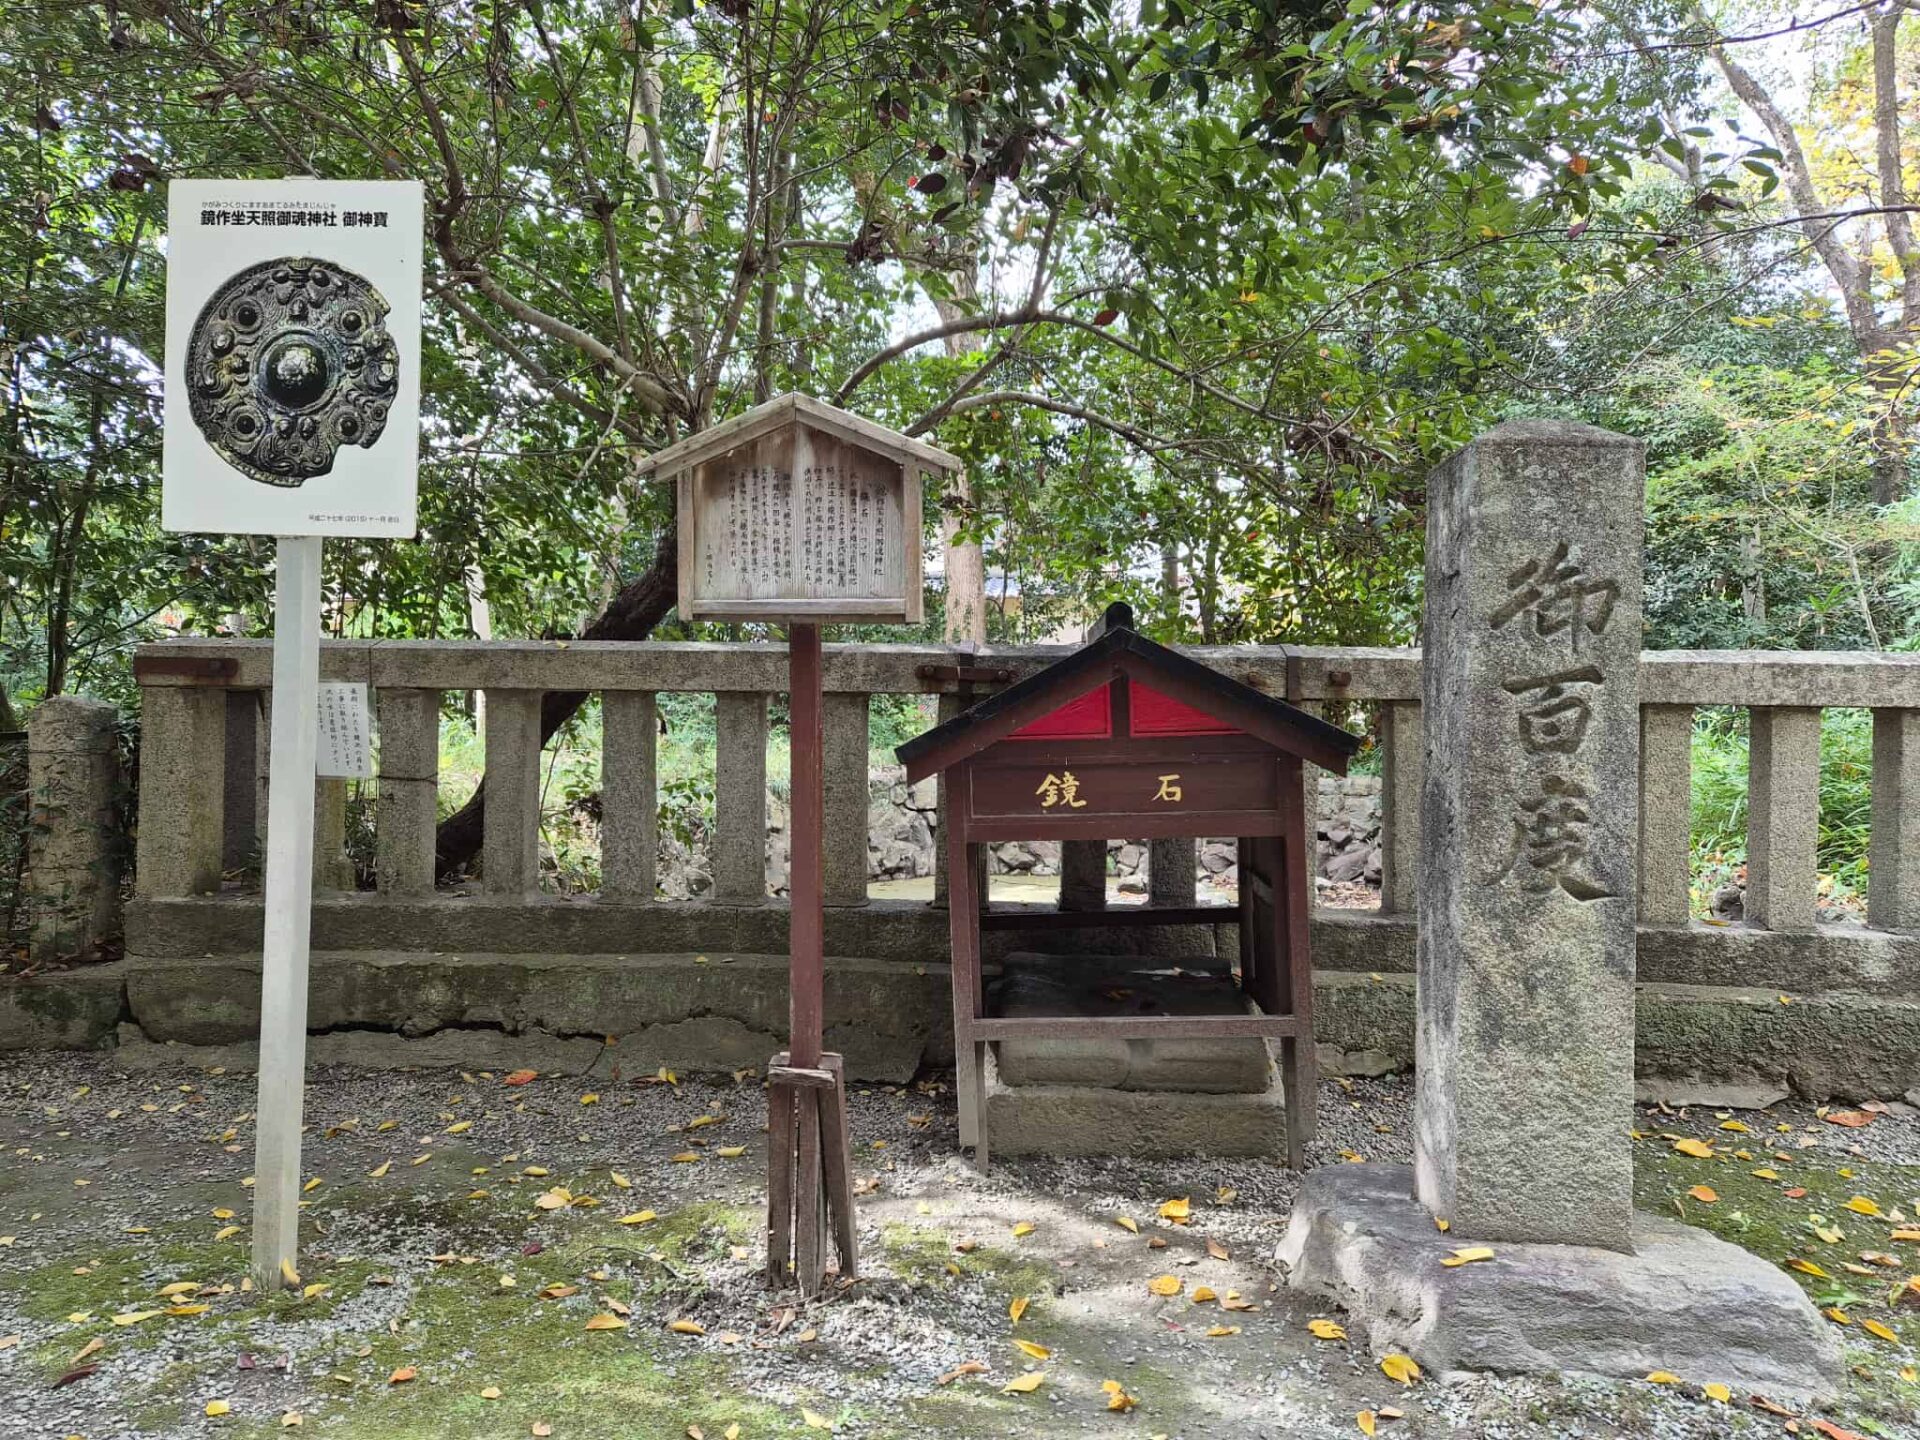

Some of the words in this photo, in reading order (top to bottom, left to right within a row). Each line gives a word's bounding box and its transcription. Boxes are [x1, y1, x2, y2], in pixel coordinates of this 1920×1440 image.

[200, 209, 338, 227] 鏡作坐天照御魂神社
[342, 211, 389, 227] 御神寶
[1483, 540, 1621, 902] 御百度
[1036, 771, 1087, 807] 鏡
[1152, 774, 1182, 802] 石
